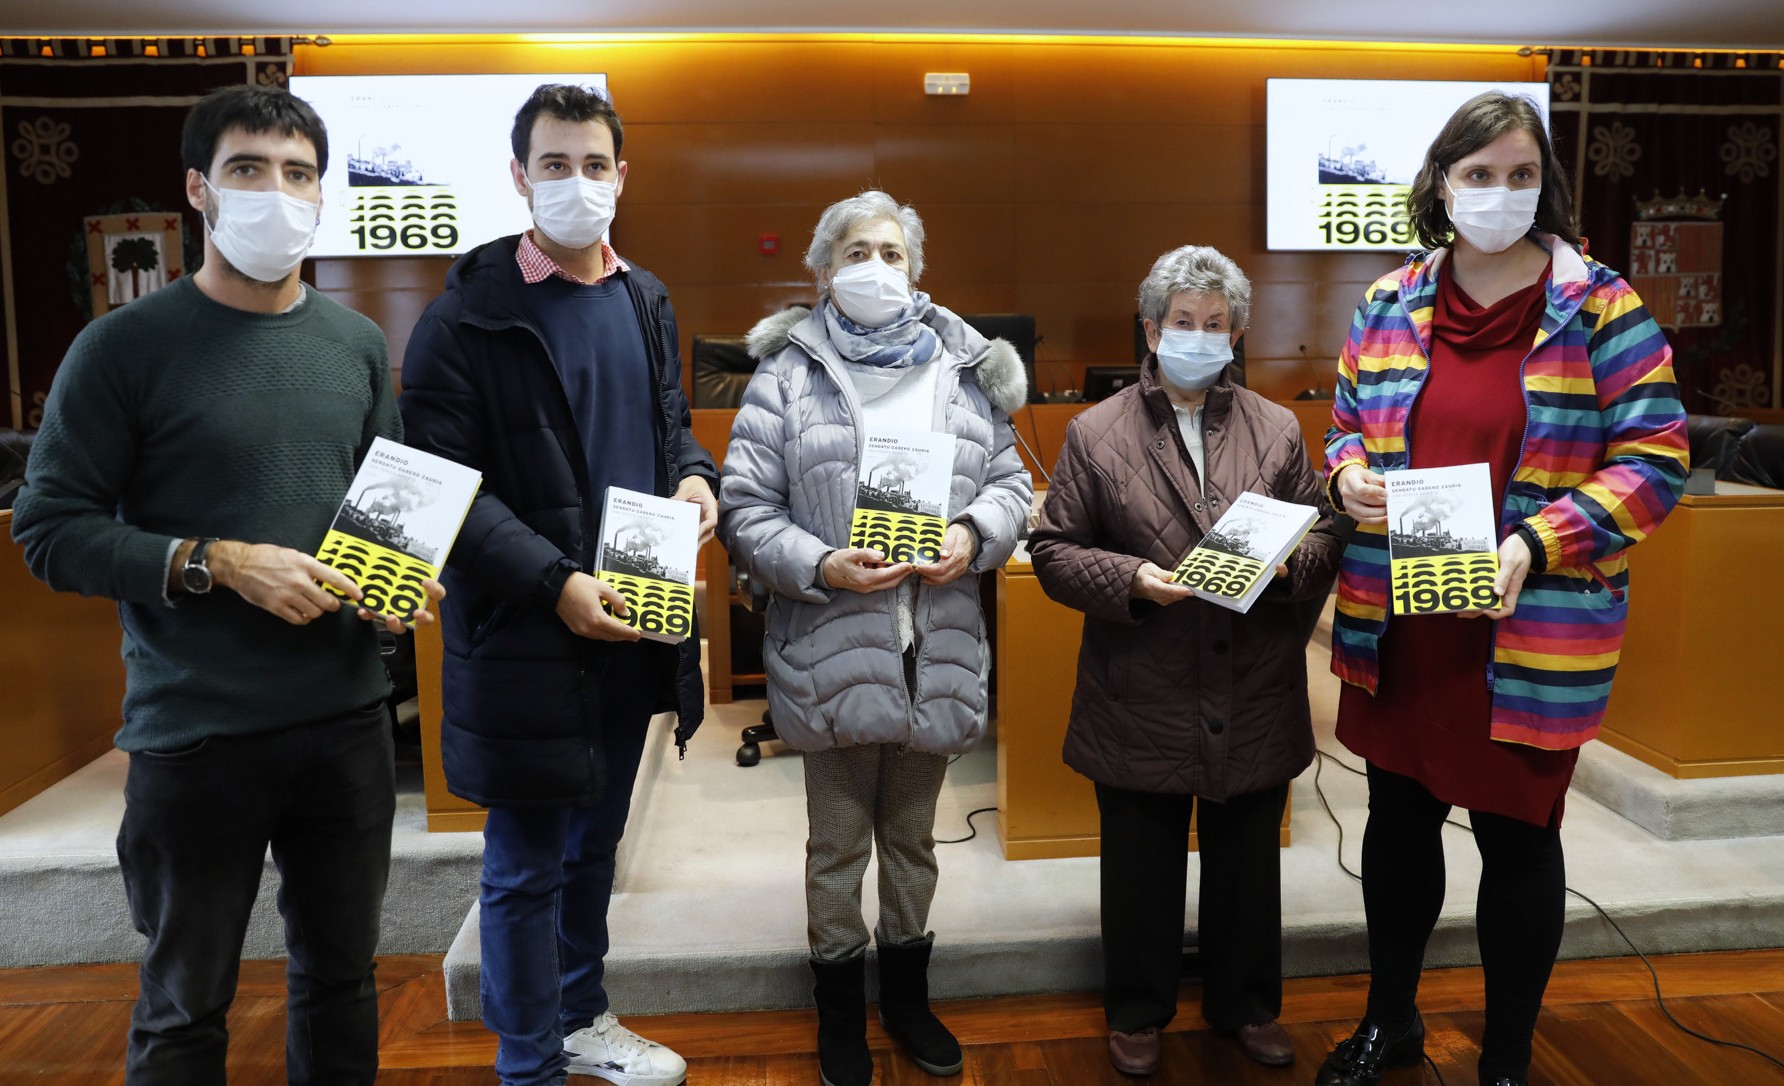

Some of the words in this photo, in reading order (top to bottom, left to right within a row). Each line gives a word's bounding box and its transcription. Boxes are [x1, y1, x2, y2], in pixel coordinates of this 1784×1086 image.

[350, 223, 458, 250] 1969
[1318, 220, 1412, 245] 1969
[374, 450, 409, 466] ERANDIO
[1391, 479, 1424, 487] ERANDIO
[613, 497, 643, 508] ERANDIO
[1175, 568, 1246, 597] 1969
[1395, 584, 1500, 614] 1969
